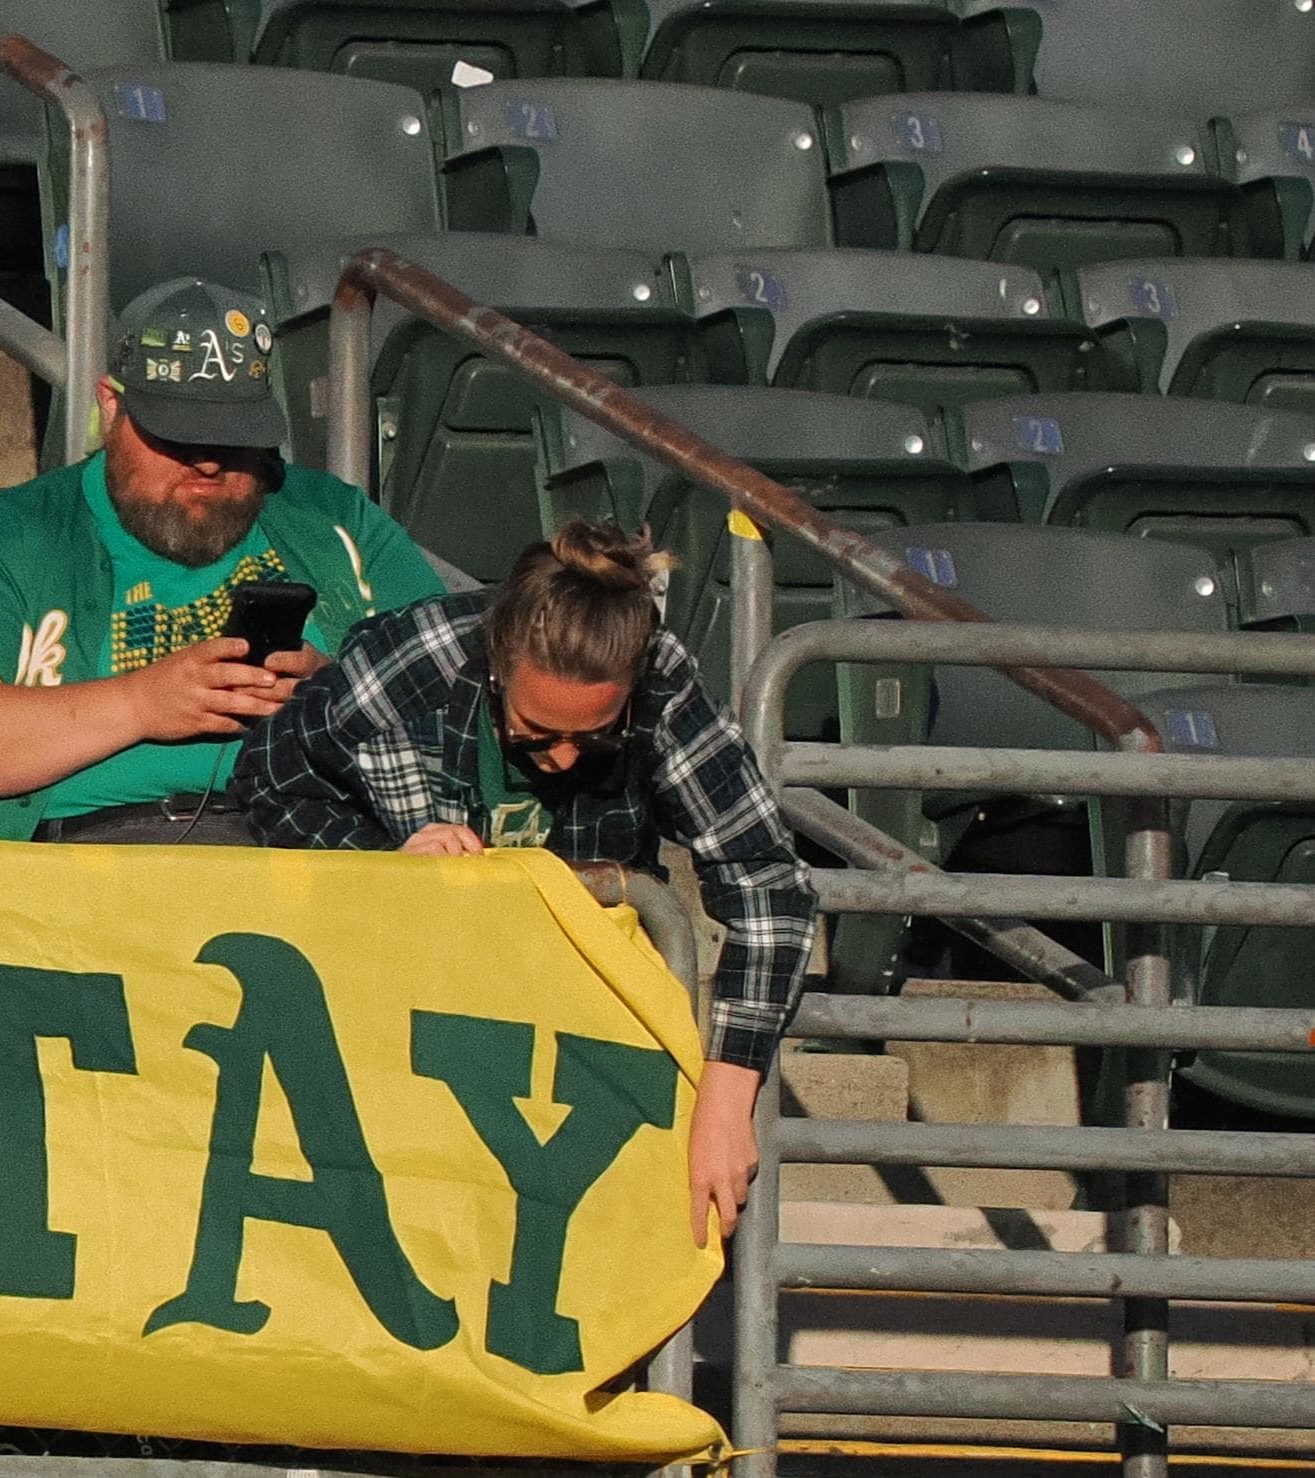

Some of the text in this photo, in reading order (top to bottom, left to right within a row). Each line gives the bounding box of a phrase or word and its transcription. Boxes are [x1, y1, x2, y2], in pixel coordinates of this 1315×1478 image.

[908, 117, 924, 148] 3
[1297, 129, 1314, 159] 4
[751, 273, 768, 302] 2
[1144, 282, 1161, 313] 3
